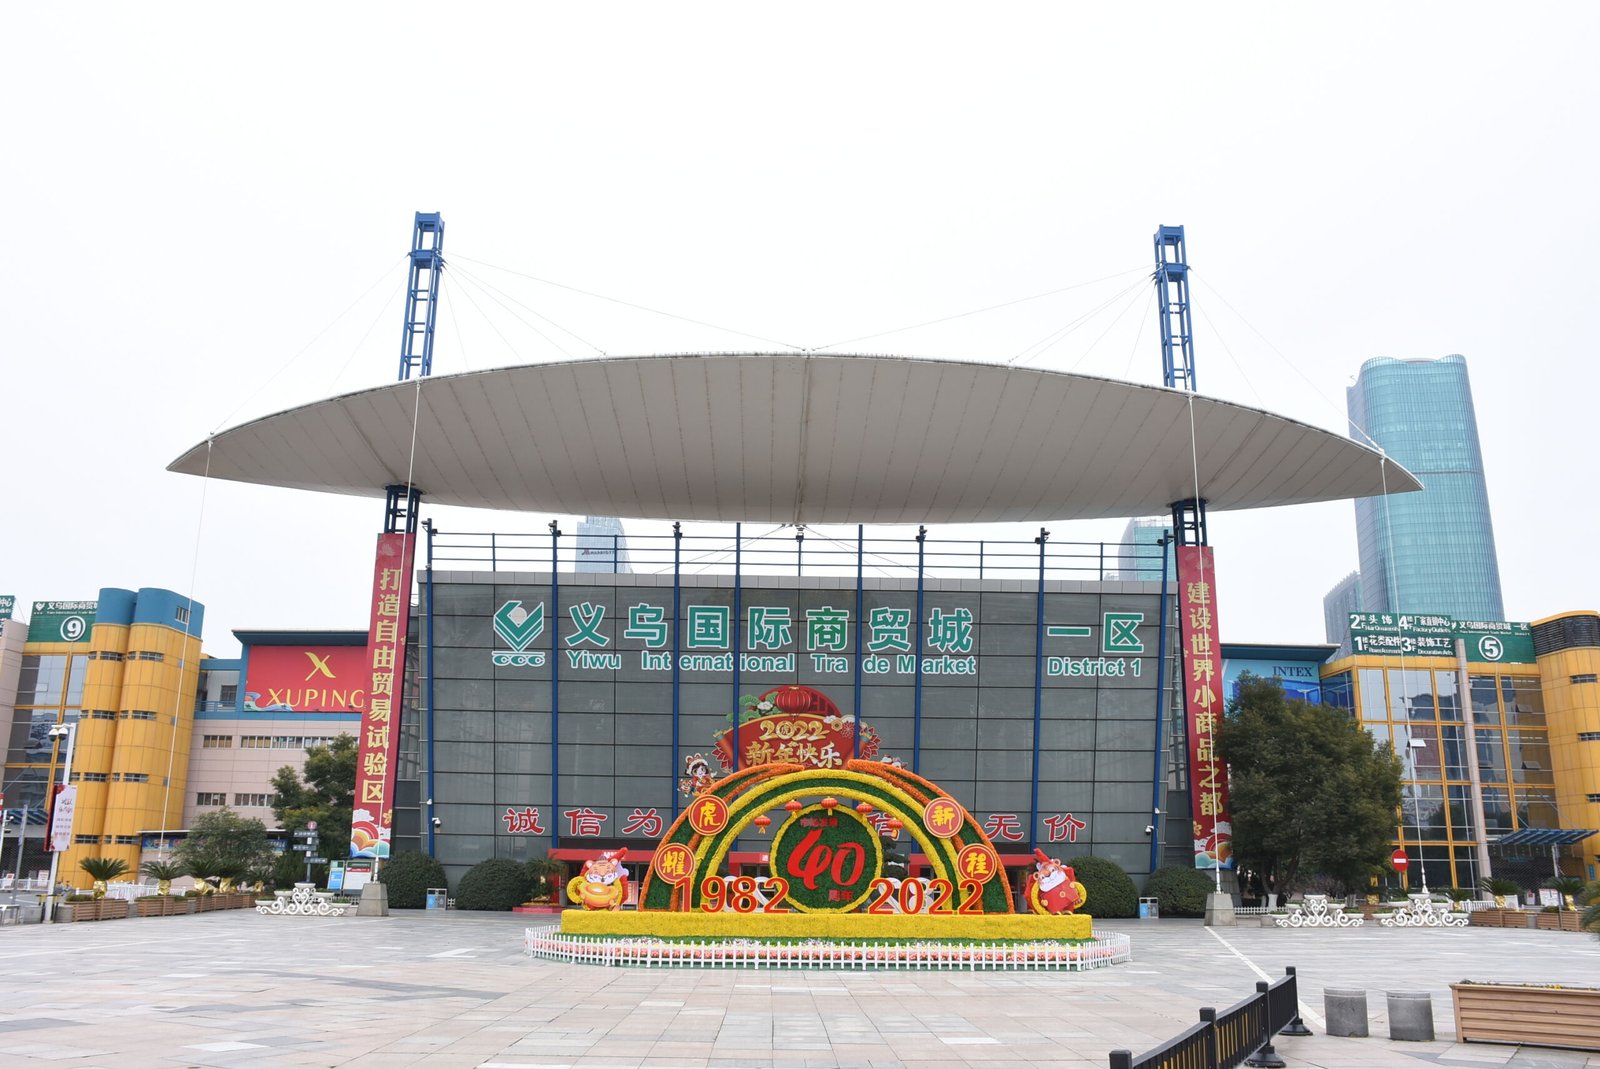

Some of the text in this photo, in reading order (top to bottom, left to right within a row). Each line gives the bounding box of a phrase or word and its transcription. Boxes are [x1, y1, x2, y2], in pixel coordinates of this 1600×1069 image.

[565, 602, 1144, 653] 义乌国际商贸城 一区
[565, 649, 621, 669] Yiwu
[1047, 657, 1125, 676] District
[1130, 658, 1142, 677] 1
[1484, 640, 1499, 658] 5
[361, 567, 401, 804] 打造自由贸易试验区
[1273, 666, 1313, 678] INTEX
[266, 688, 365, 709] XUPING
[1187, 581, 1224, 816] 建设世界小商品之都
[759, 720, 830, 741] 2022
[745, 741, 843, 769] 新年快乐
[787, 829, 865, 891] 40
[674, 875, 790, 914] 1982
[868, 877, 984, 915] 2022
